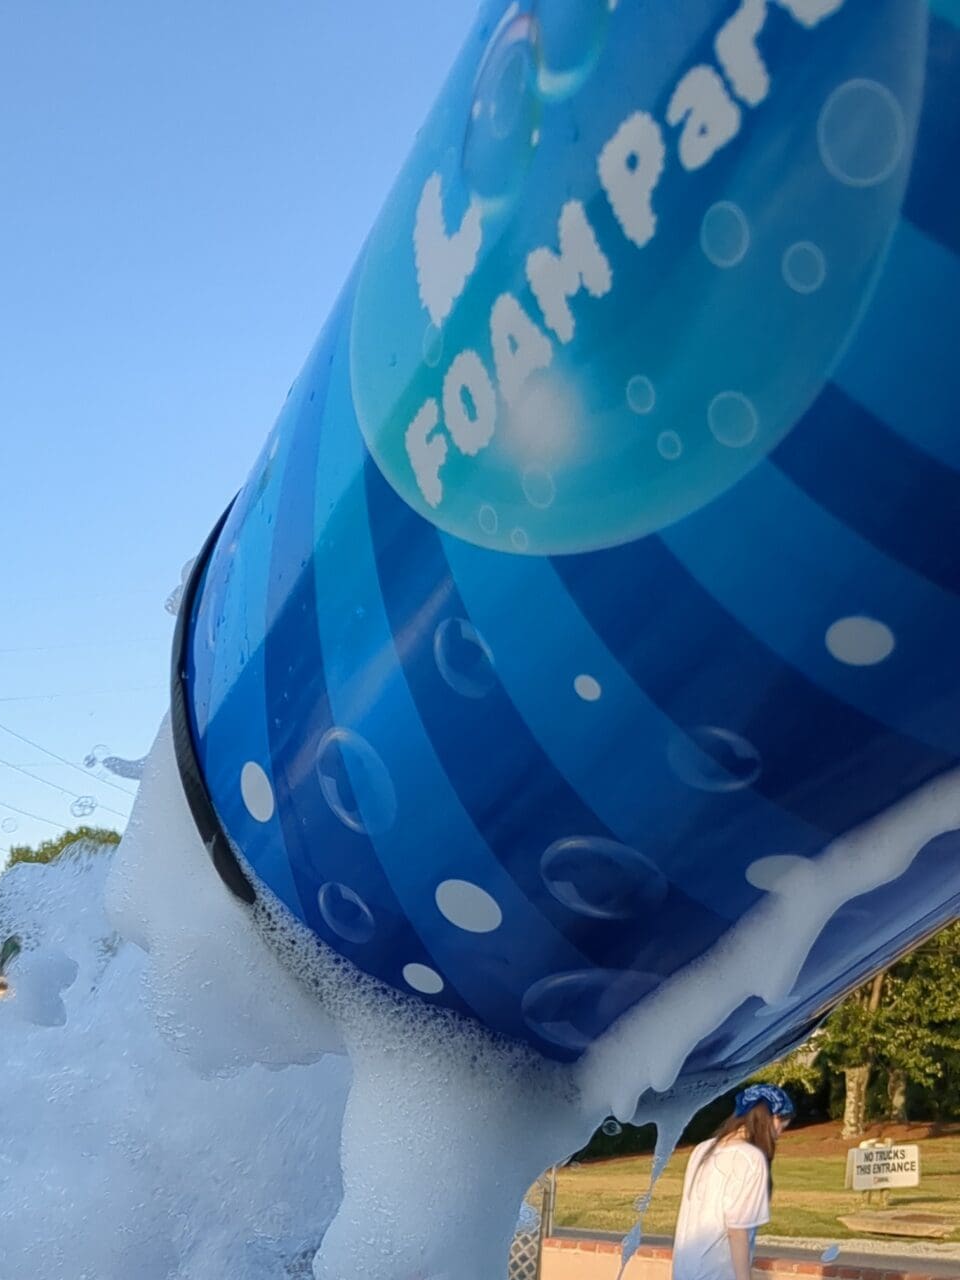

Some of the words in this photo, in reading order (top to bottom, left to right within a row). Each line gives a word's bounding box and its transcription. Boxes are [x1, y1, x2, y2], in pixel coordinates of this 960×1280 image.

[405, 199, 613, 508] FOAM
[863, 1151, 875, 1162] NO
[876, 1149, 906, 1161] TRUCKS
[856, 1163, 872, 1176] THIS
[872, 1161, 917, 1174] ENTRANCE
